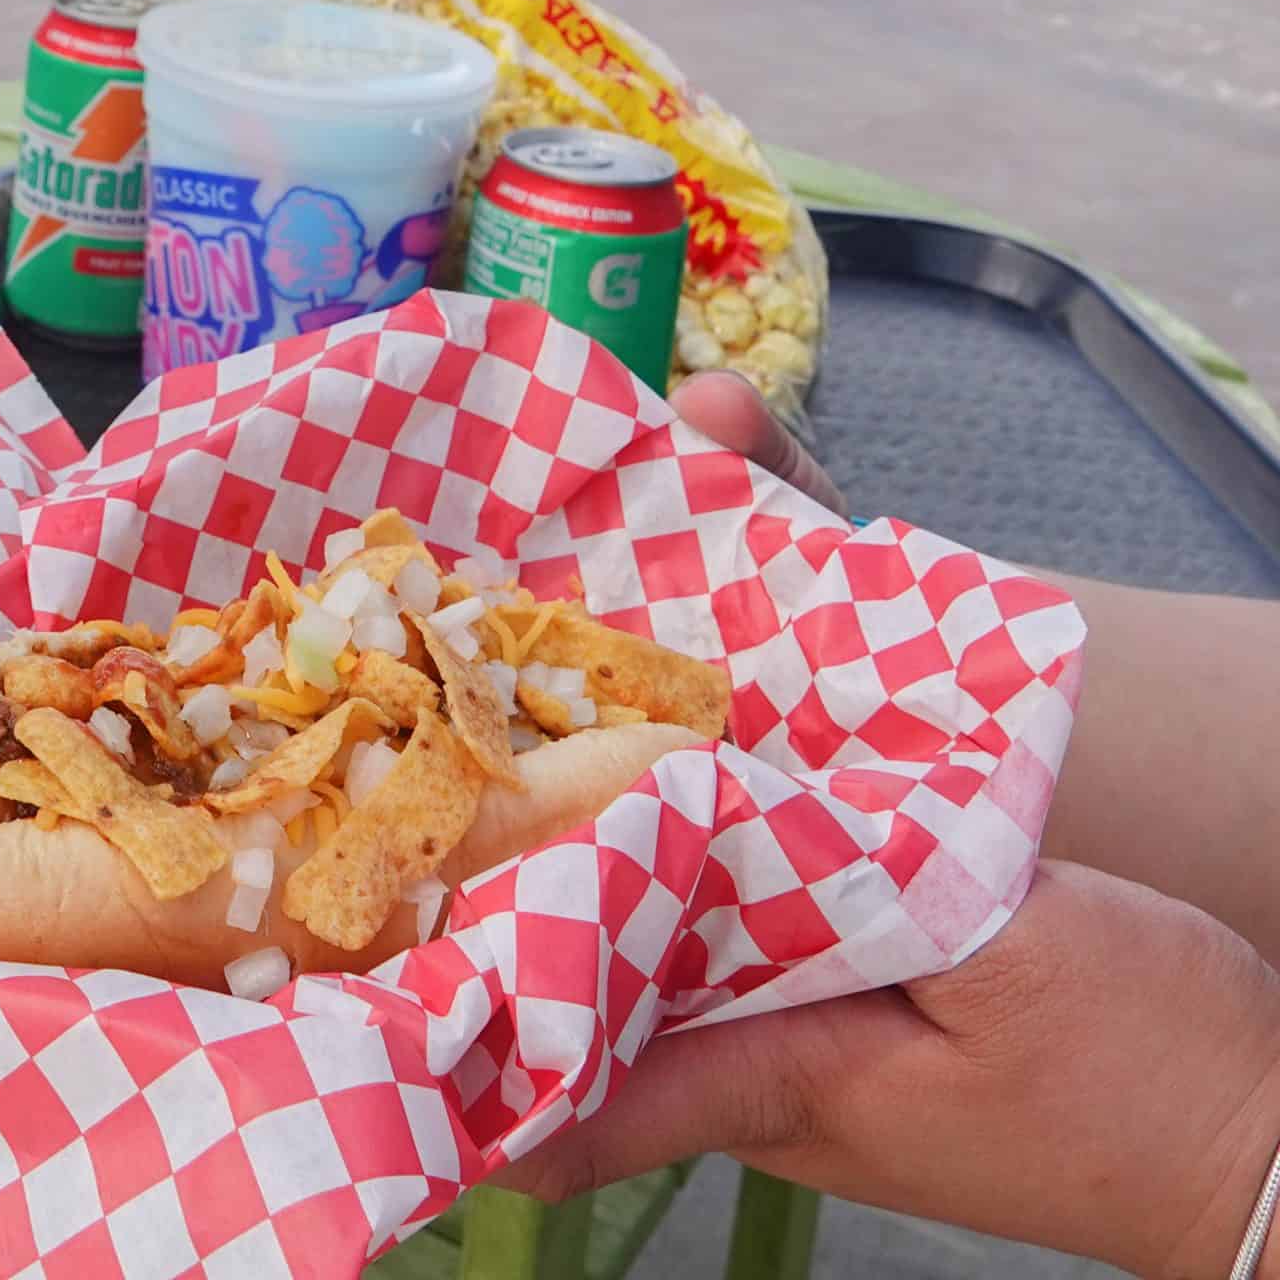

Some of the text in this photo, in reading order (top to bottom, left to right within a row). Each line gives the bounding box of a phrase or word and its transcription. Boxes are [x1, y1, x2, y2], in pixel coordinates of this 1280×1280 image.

[649, 87, 680, 124] A
[154, 176, 238, 211] CLASSIC
[587, 252, 645, 311] G
